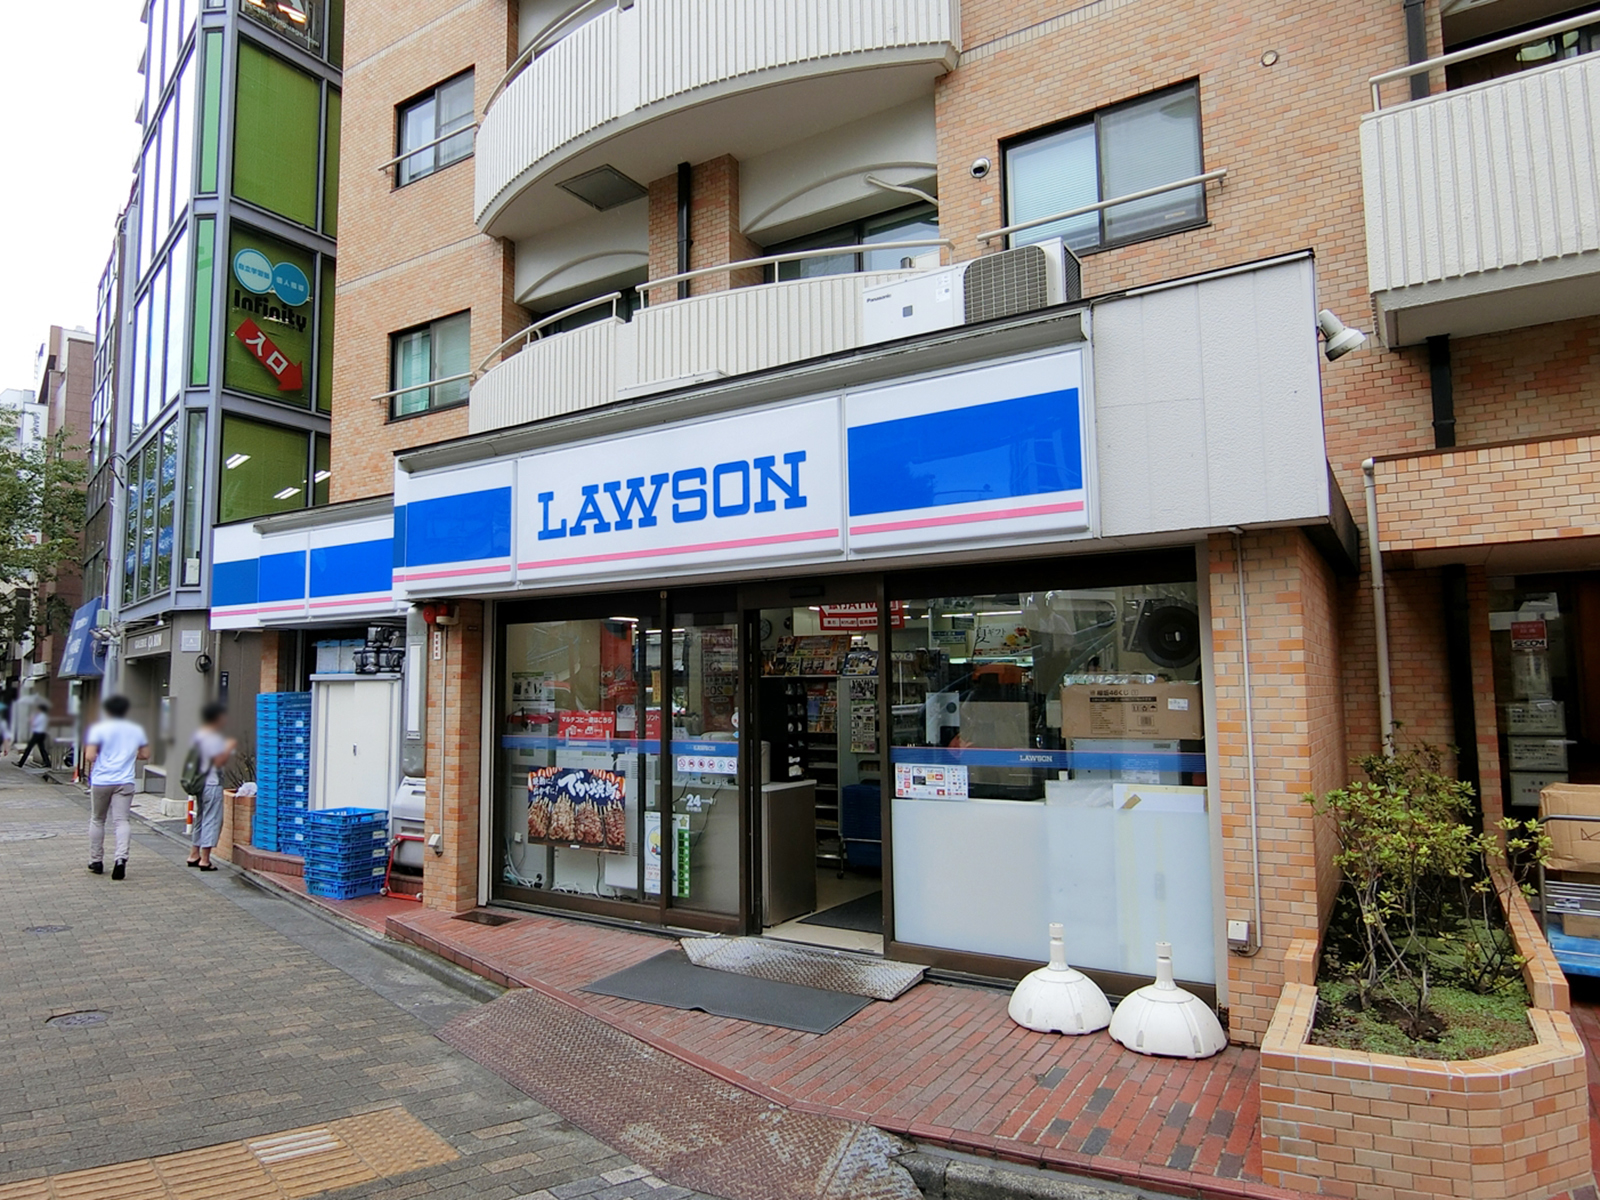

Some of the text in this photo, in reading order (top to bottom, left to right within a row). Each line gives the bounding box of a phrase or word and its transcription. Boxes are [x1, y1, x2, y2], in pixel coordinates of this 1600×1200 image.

[234, 289, 307, 333] Infinity
[866, 293, 892, 304] Panasonic
[245, 331, 289, 375] 入口
[538, 450, 807, 540] LAWSON
[1019, 754, 1053, 763] LAWSON
[686, 793, 701, 807] 24
